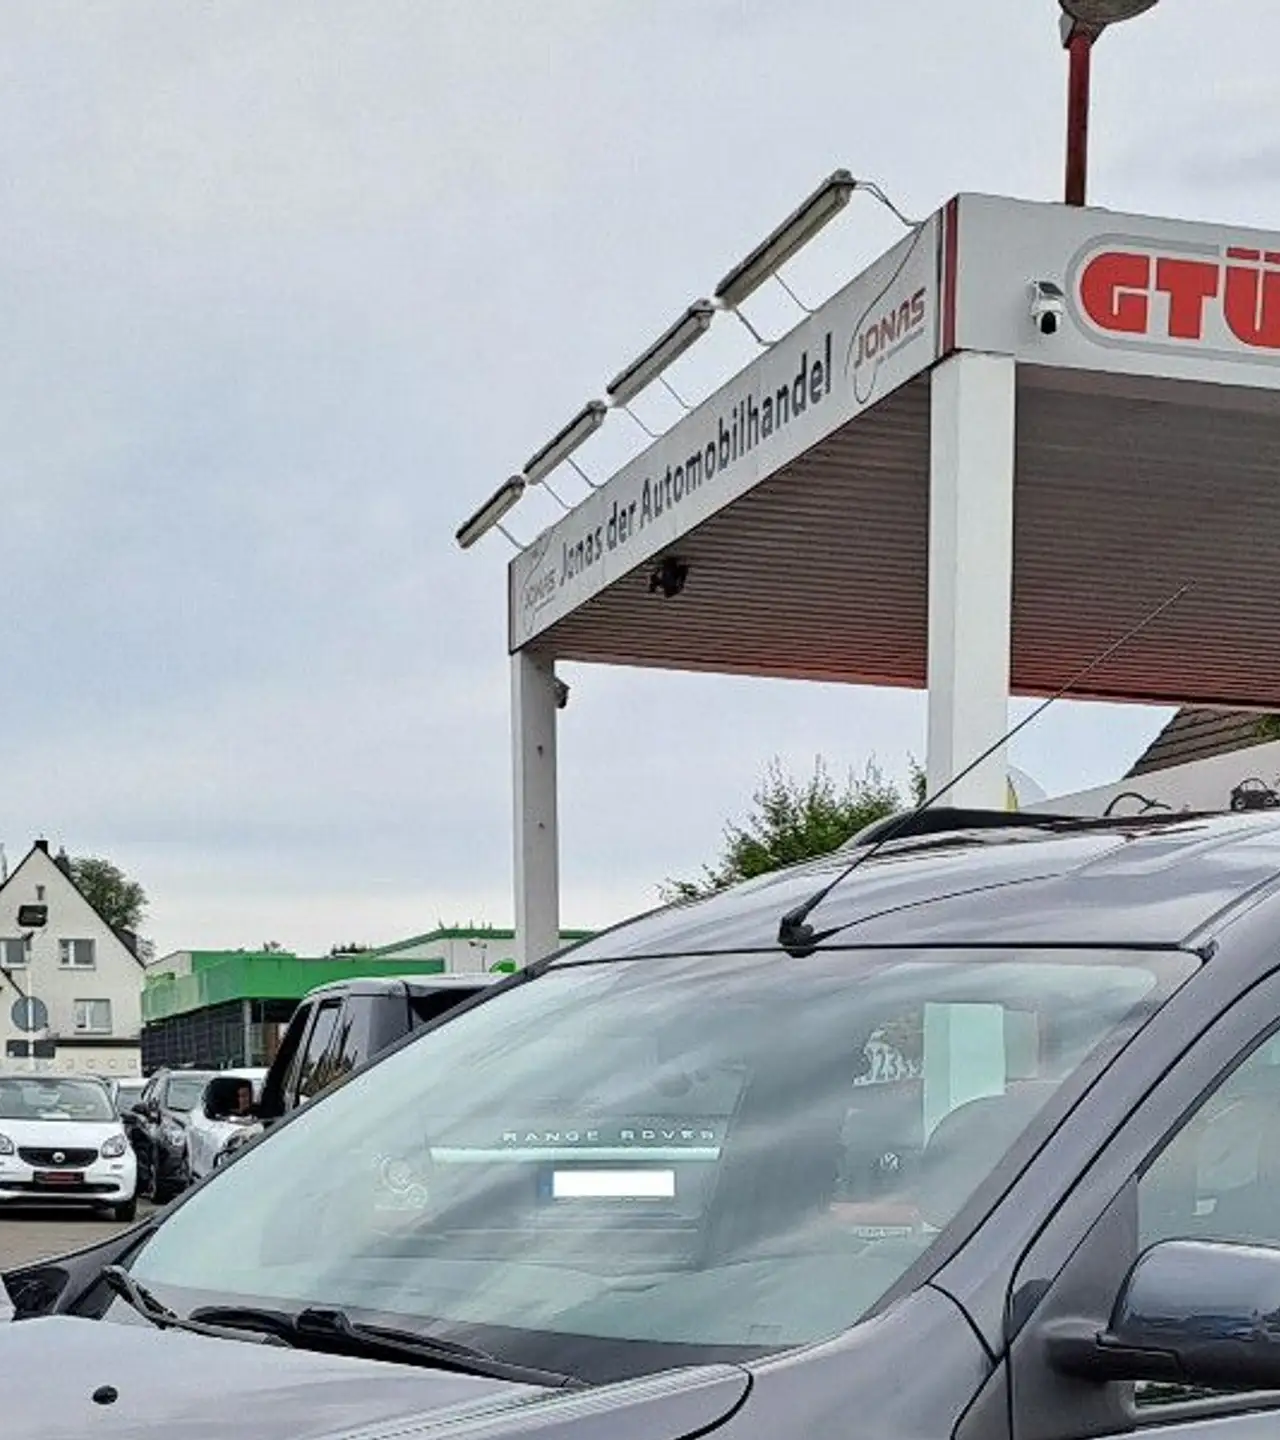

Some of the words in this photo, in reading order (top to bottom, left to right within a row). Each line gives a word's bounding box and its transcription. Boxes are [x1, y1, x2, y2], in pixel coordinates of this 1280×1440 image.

[853, 286, 927, 369] JONAS
[558, 525, 604, 587] Jonas
[606, 500, 637, 551] der
[639, 332, 833, 530] Automobilhandel
[502, 1129, 600, 1142] RANGE
[619, 1129, 715, 1141] ROVER
